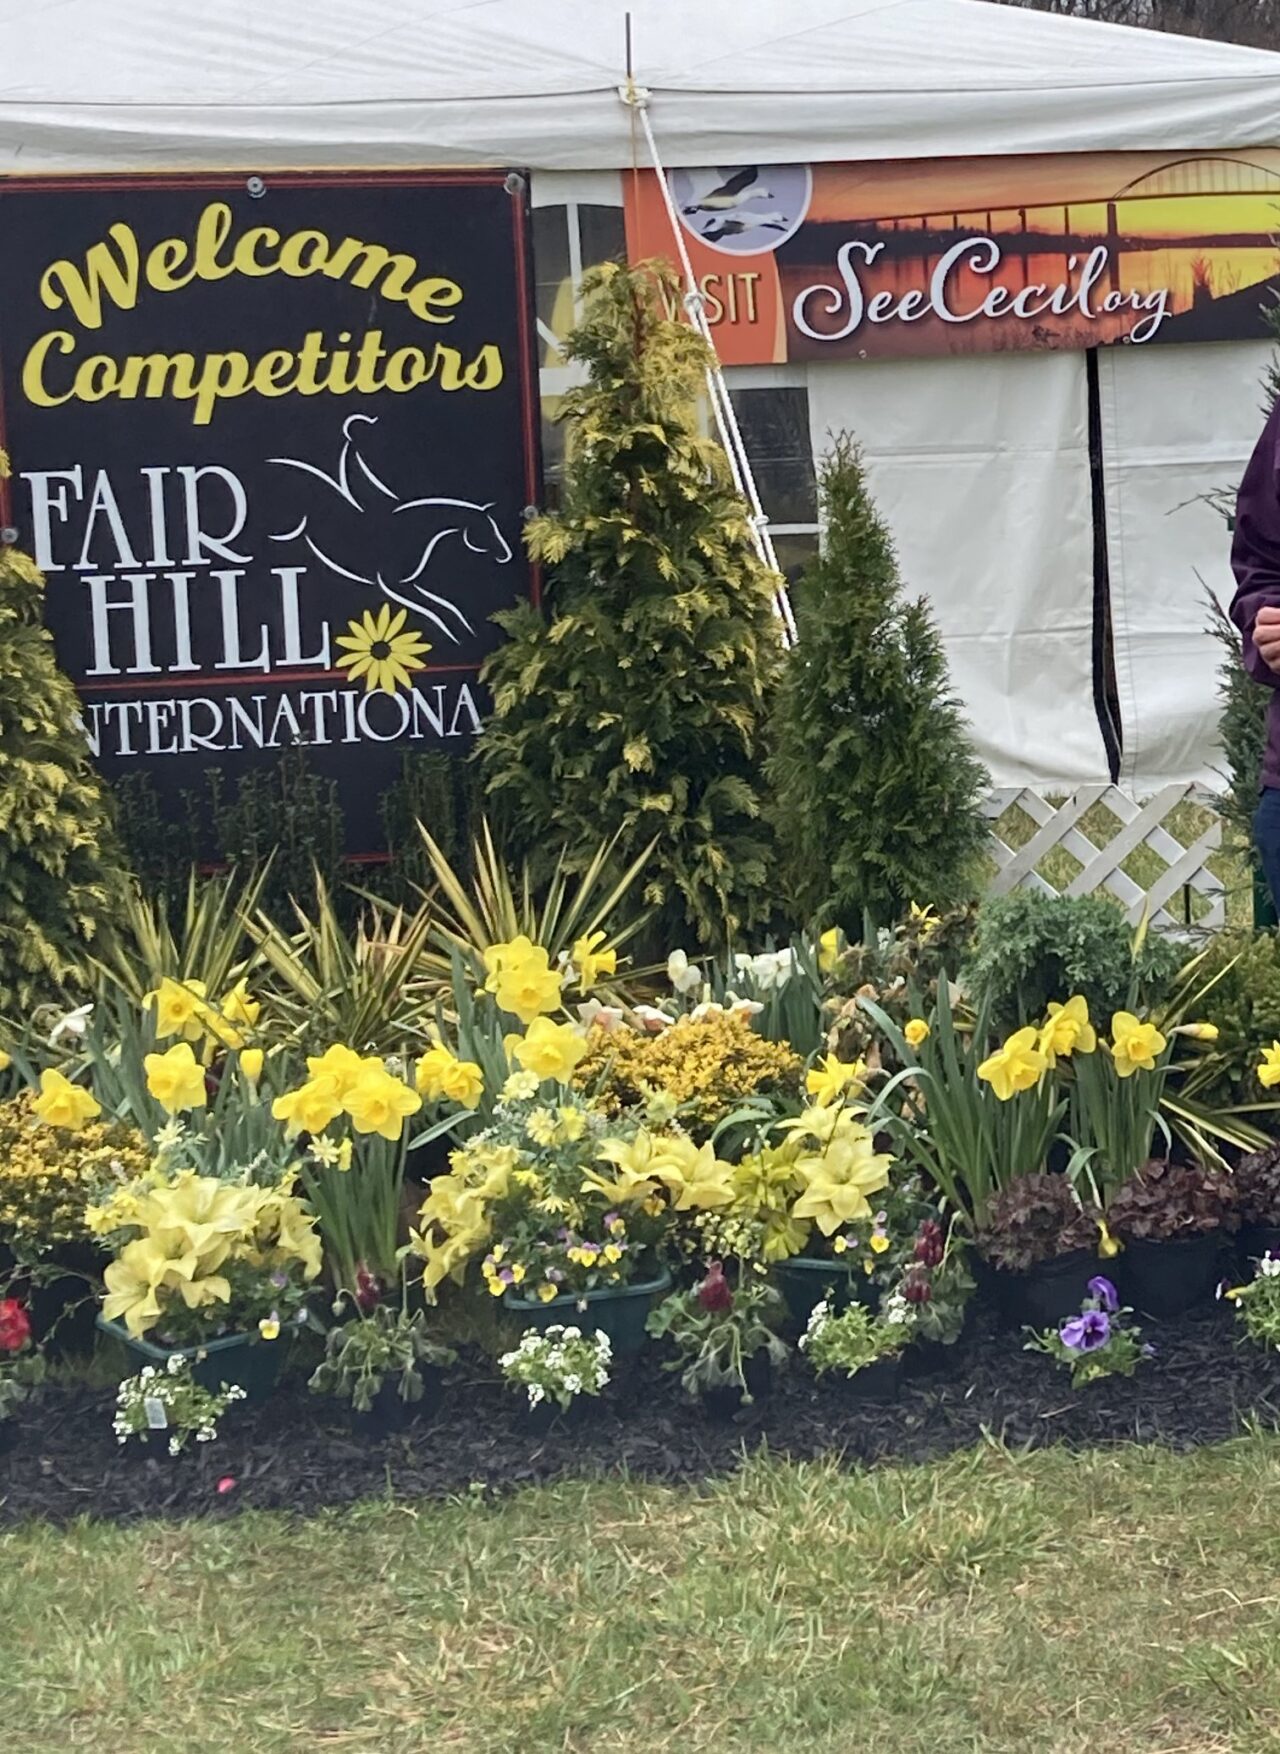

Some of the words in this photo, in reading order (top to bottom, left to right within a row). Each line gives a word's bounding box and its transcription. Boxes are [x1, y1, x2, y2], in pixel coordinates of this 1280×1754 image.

[40, 201, 464, 329] Welcome
[656, 272, 759, 324] VSIT
[21, 329, 503, 425] Competitors
[19, 463, 254, 572] FAIR
[80, 566, 331, 676] HILL
[71, 682, 486, 758] NTERNATIONA
